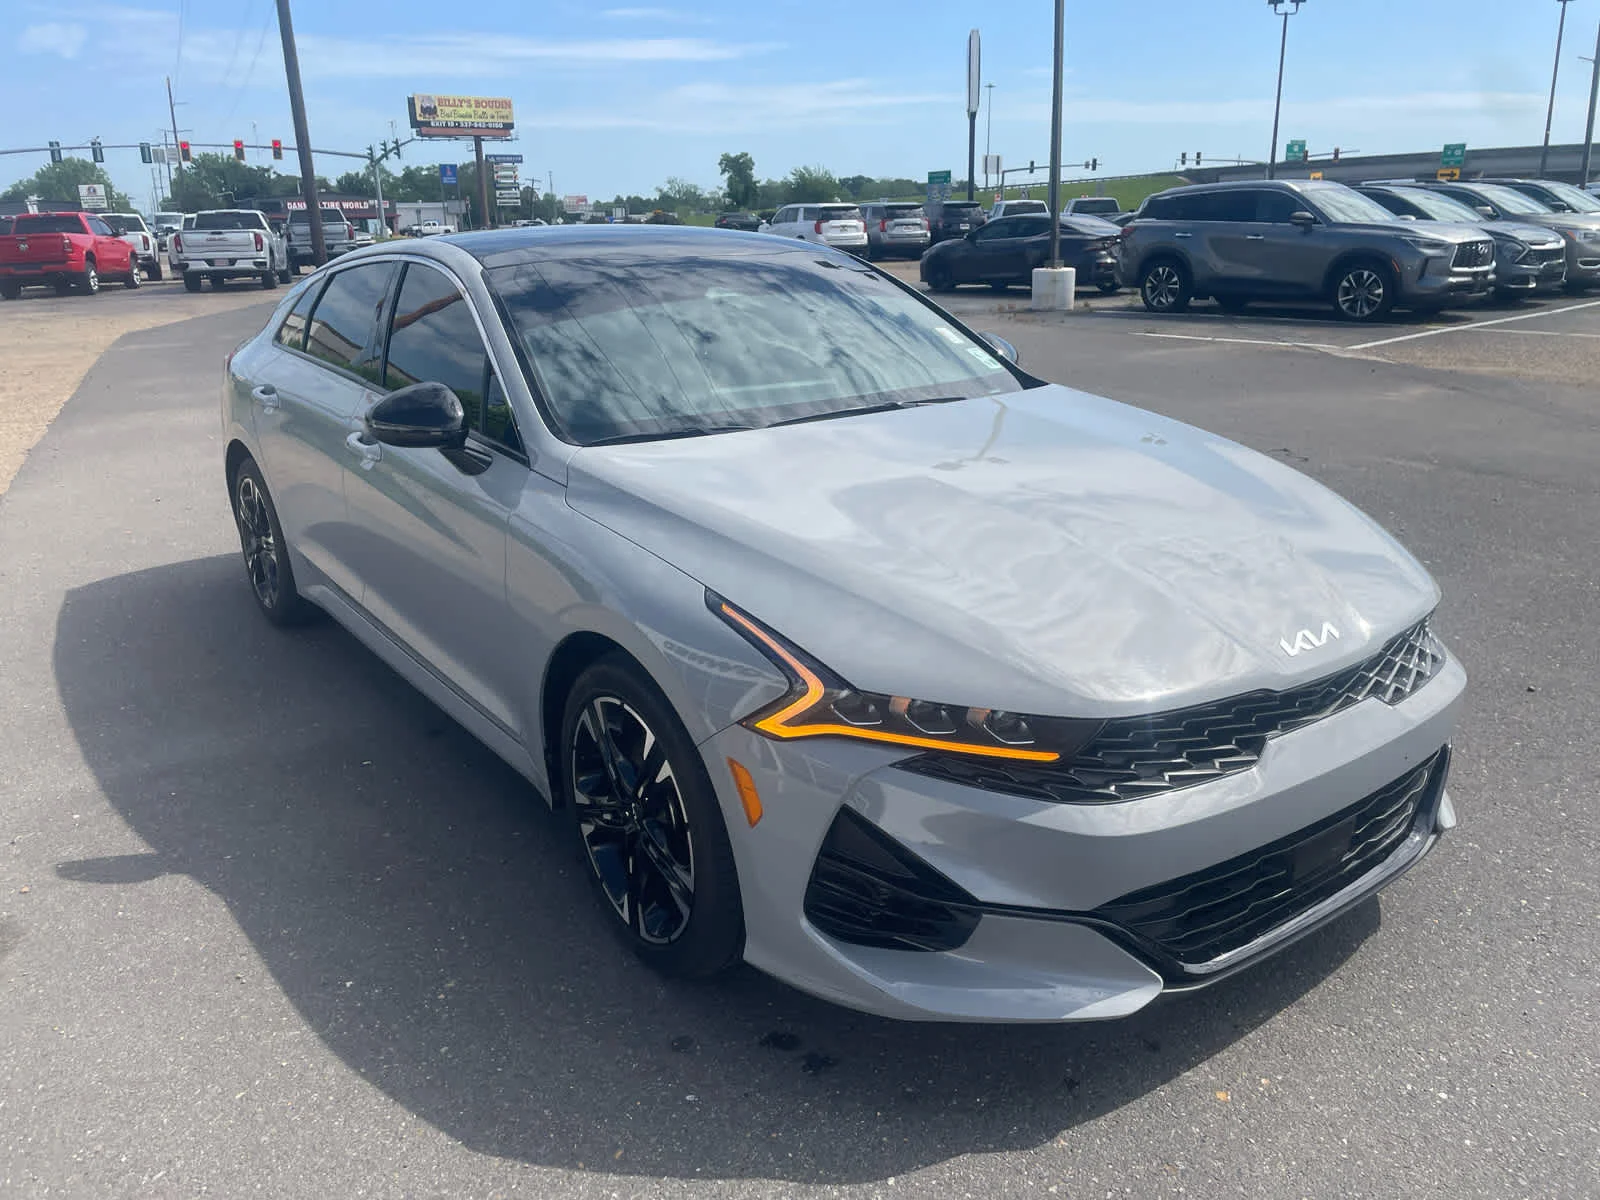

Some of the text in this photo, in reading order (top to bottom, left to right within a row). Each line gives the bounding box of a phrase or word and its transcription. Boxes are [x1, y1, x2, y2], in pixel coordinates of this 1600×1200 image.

[437, 97, 512, 109] BILLY'S BOUDIN
[322, 201, 341, 209] TIRE
[342, 201, 369, 209] WORLD
[1280, 622, 1339, 657] KIA
